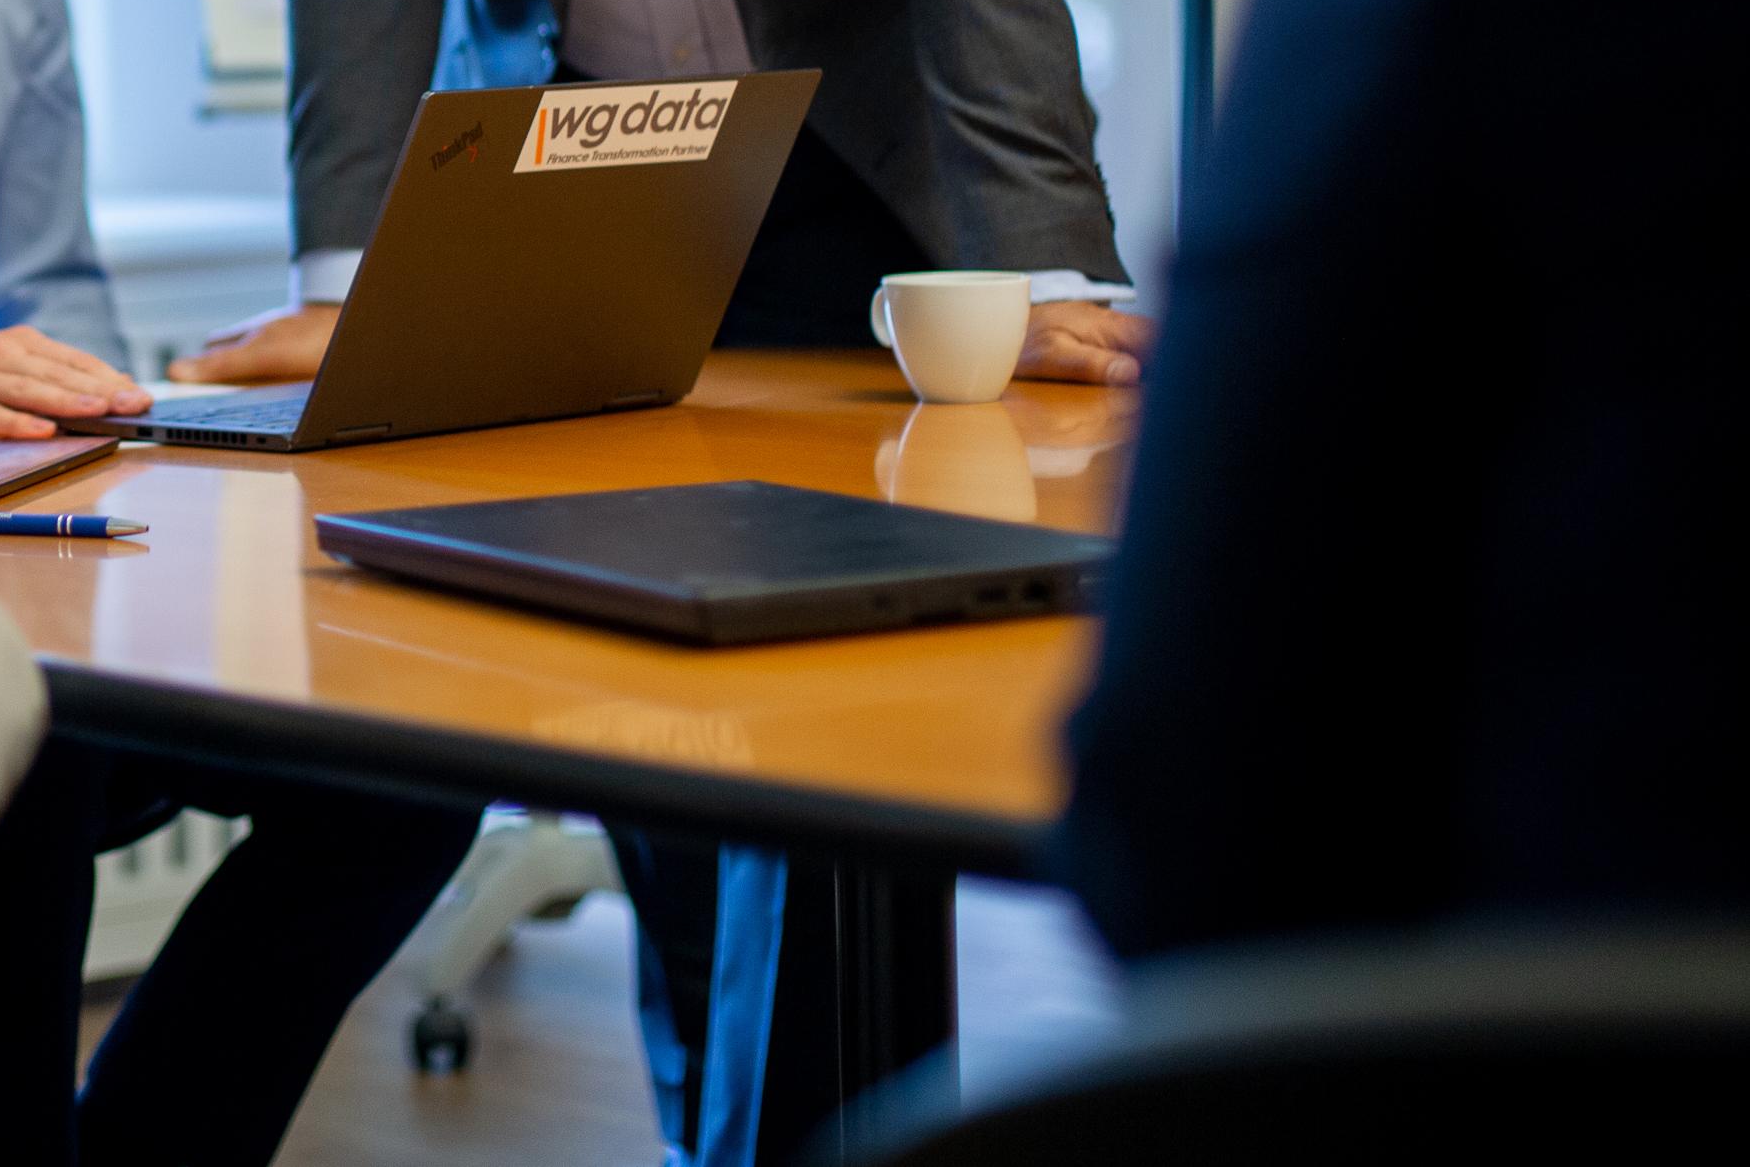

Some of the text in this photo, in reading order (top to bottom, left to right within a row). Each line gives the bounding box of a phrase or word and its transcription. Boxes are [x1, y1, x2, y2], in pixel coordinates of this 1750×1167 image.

[550, 88, 728, 149] wg data
[546, 145, 710, 165] Finance Transformation Partner
